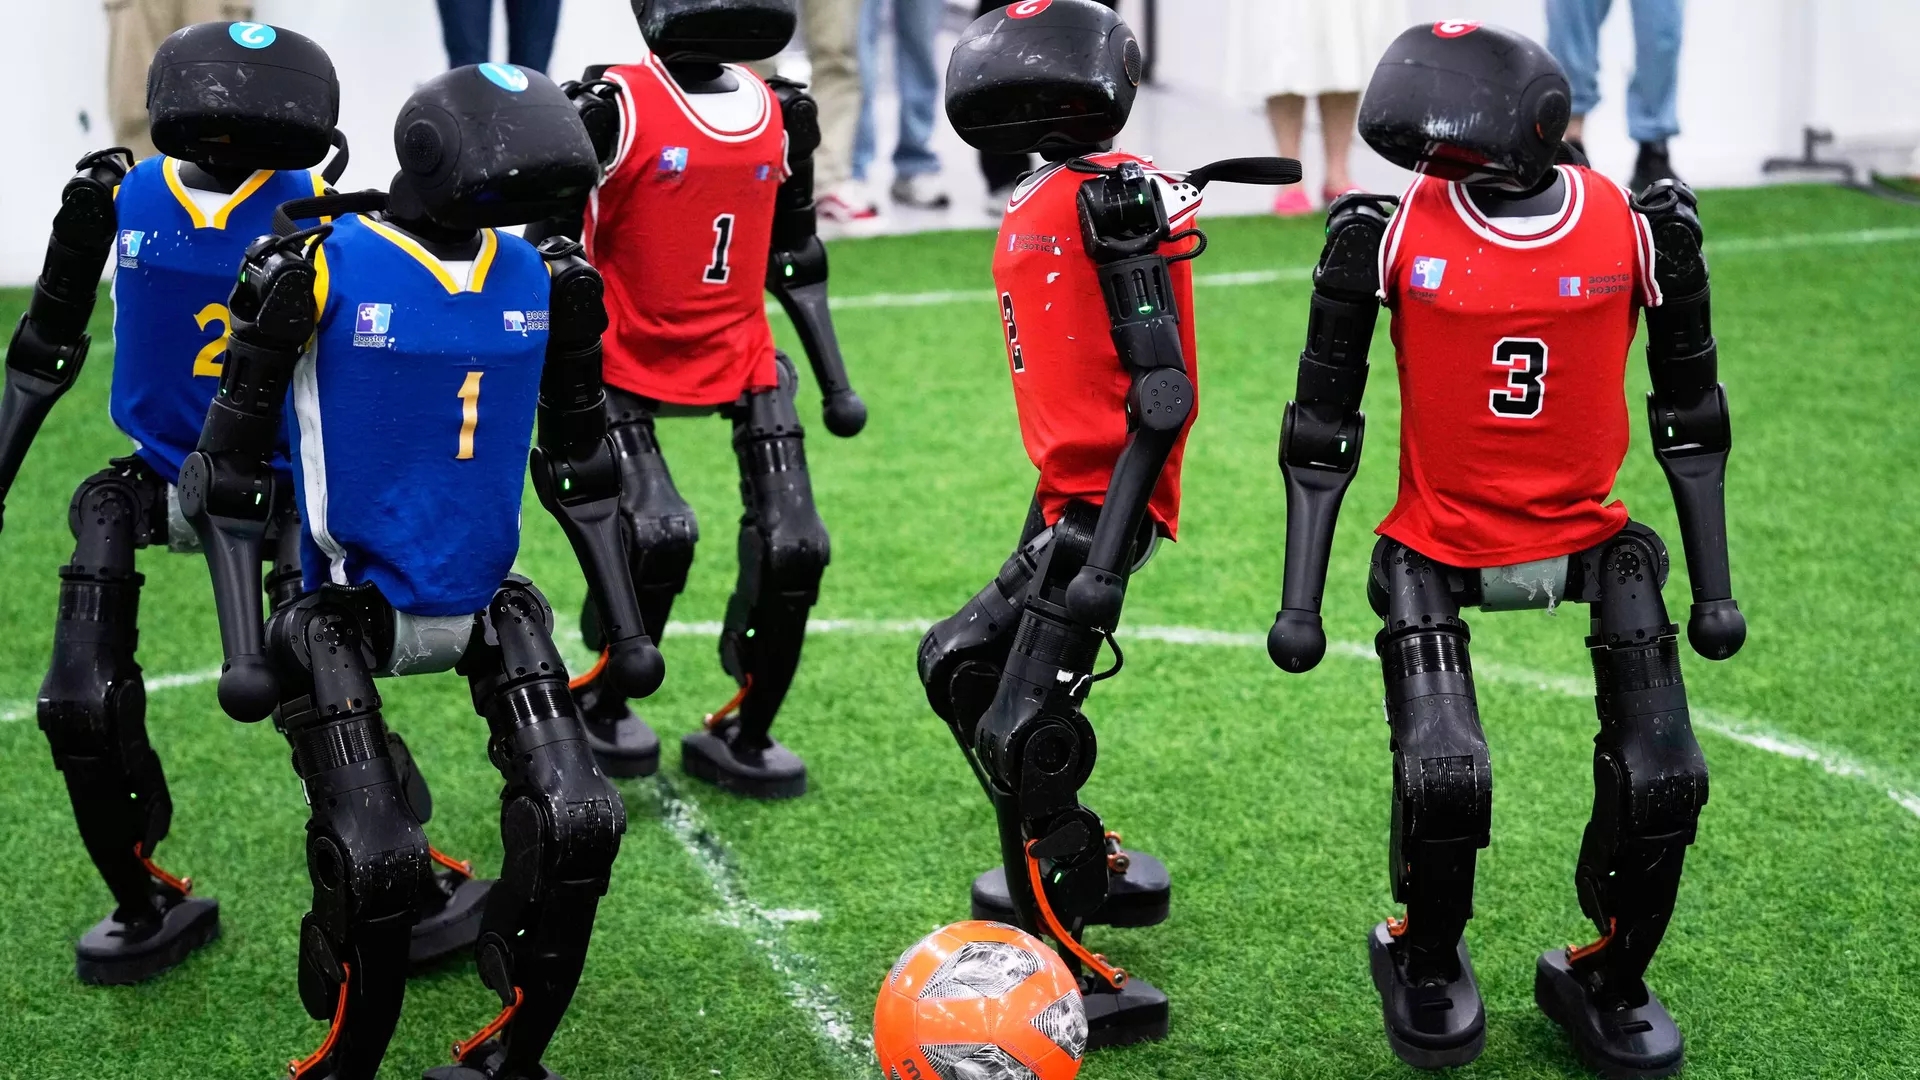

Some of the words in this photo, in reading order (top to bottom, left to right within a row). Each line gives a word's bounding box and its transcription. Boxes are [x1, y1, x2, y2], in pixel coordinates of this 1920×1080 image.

[240, 21, 265, 44] 2
[702, 213, 735, 284] 1
[192, 302, 233, 378] 2
[353, 333, 387, 342] Booster
[1002, 291, 1025, 374] 2
[456, 371, 484, 460] 1
[1488, 337, 1549, 419] 3
